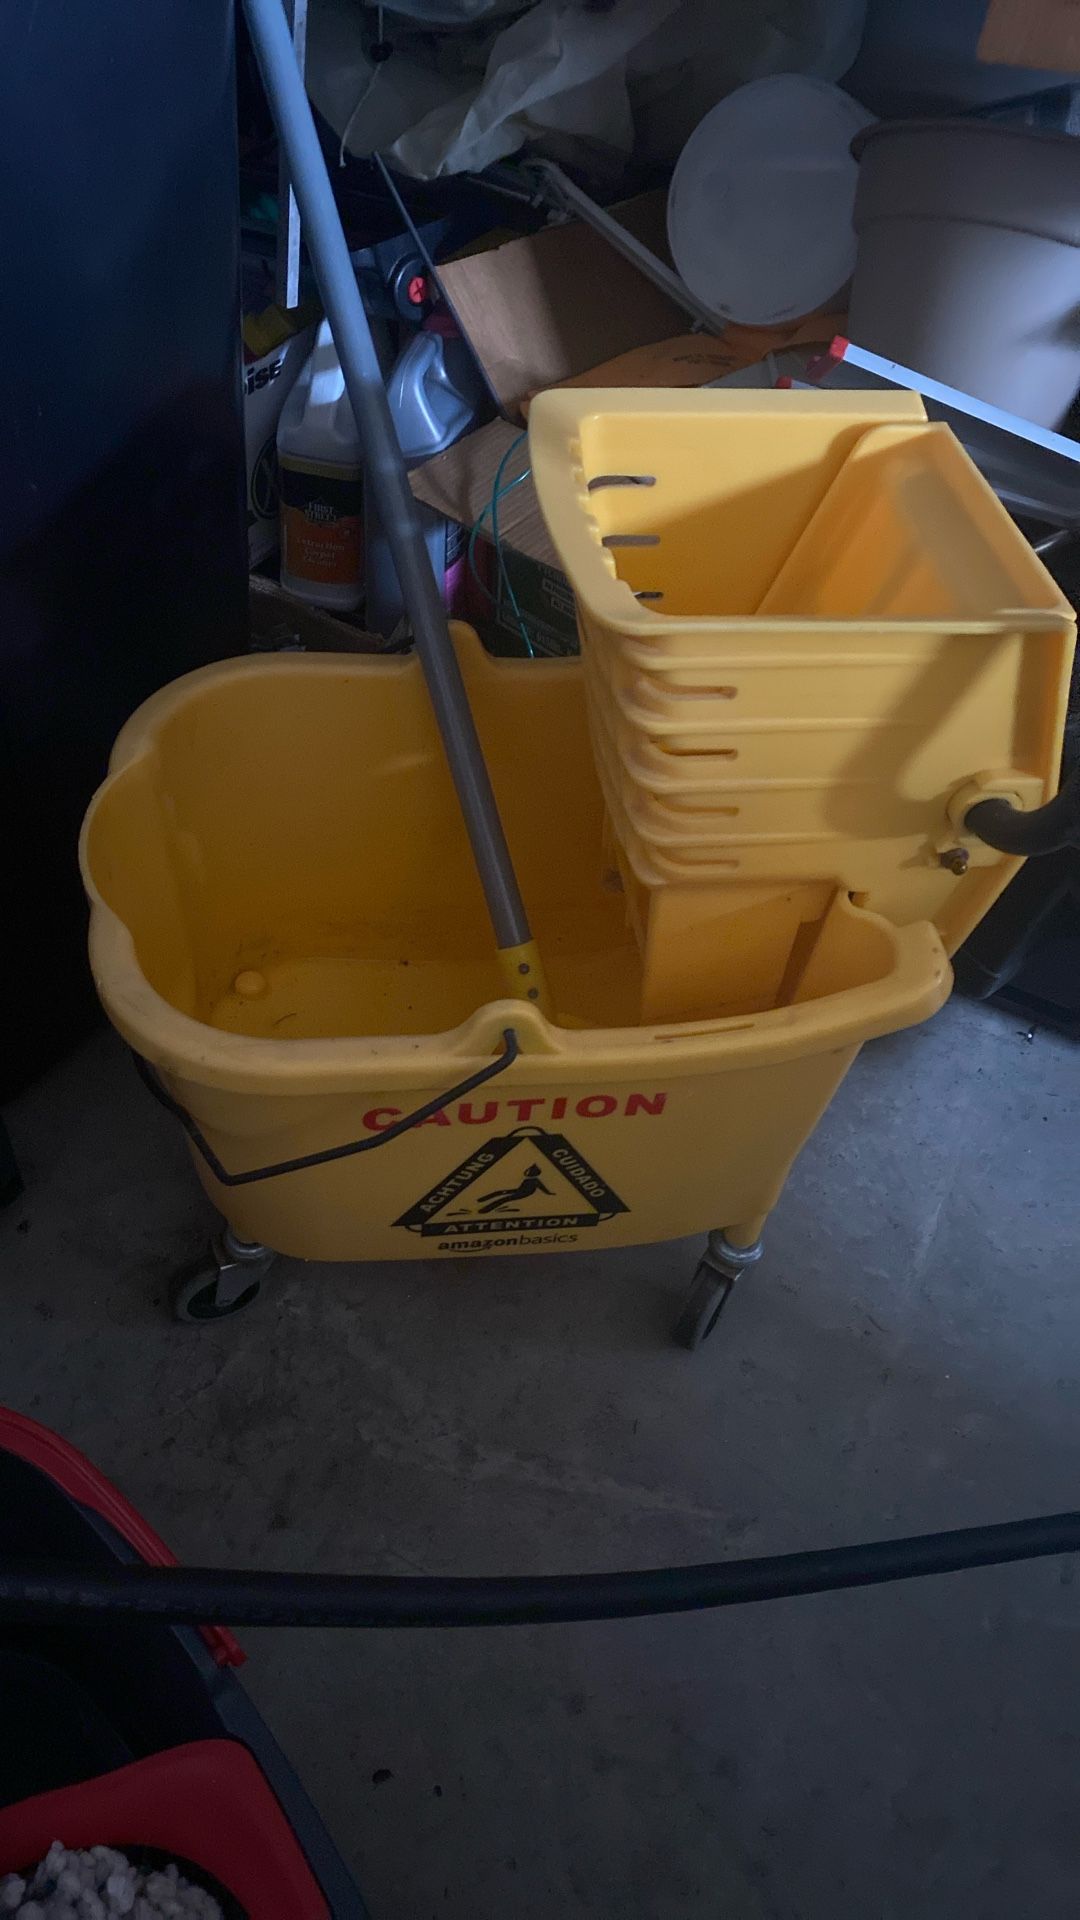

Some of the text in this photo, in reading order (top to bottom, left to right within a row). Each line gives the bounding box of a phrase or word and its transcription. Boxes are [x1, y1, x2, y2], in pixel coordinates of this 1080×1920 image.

[244, 359, 281, 395] ise
[362, 1092, 668, 1131] CAUTION
[418, 1151, 496, 1213] ACHTUNG
[551, 1148, 606, 1199] CUIDADO
[444, 1216, 579, 1233] ATTENTION
